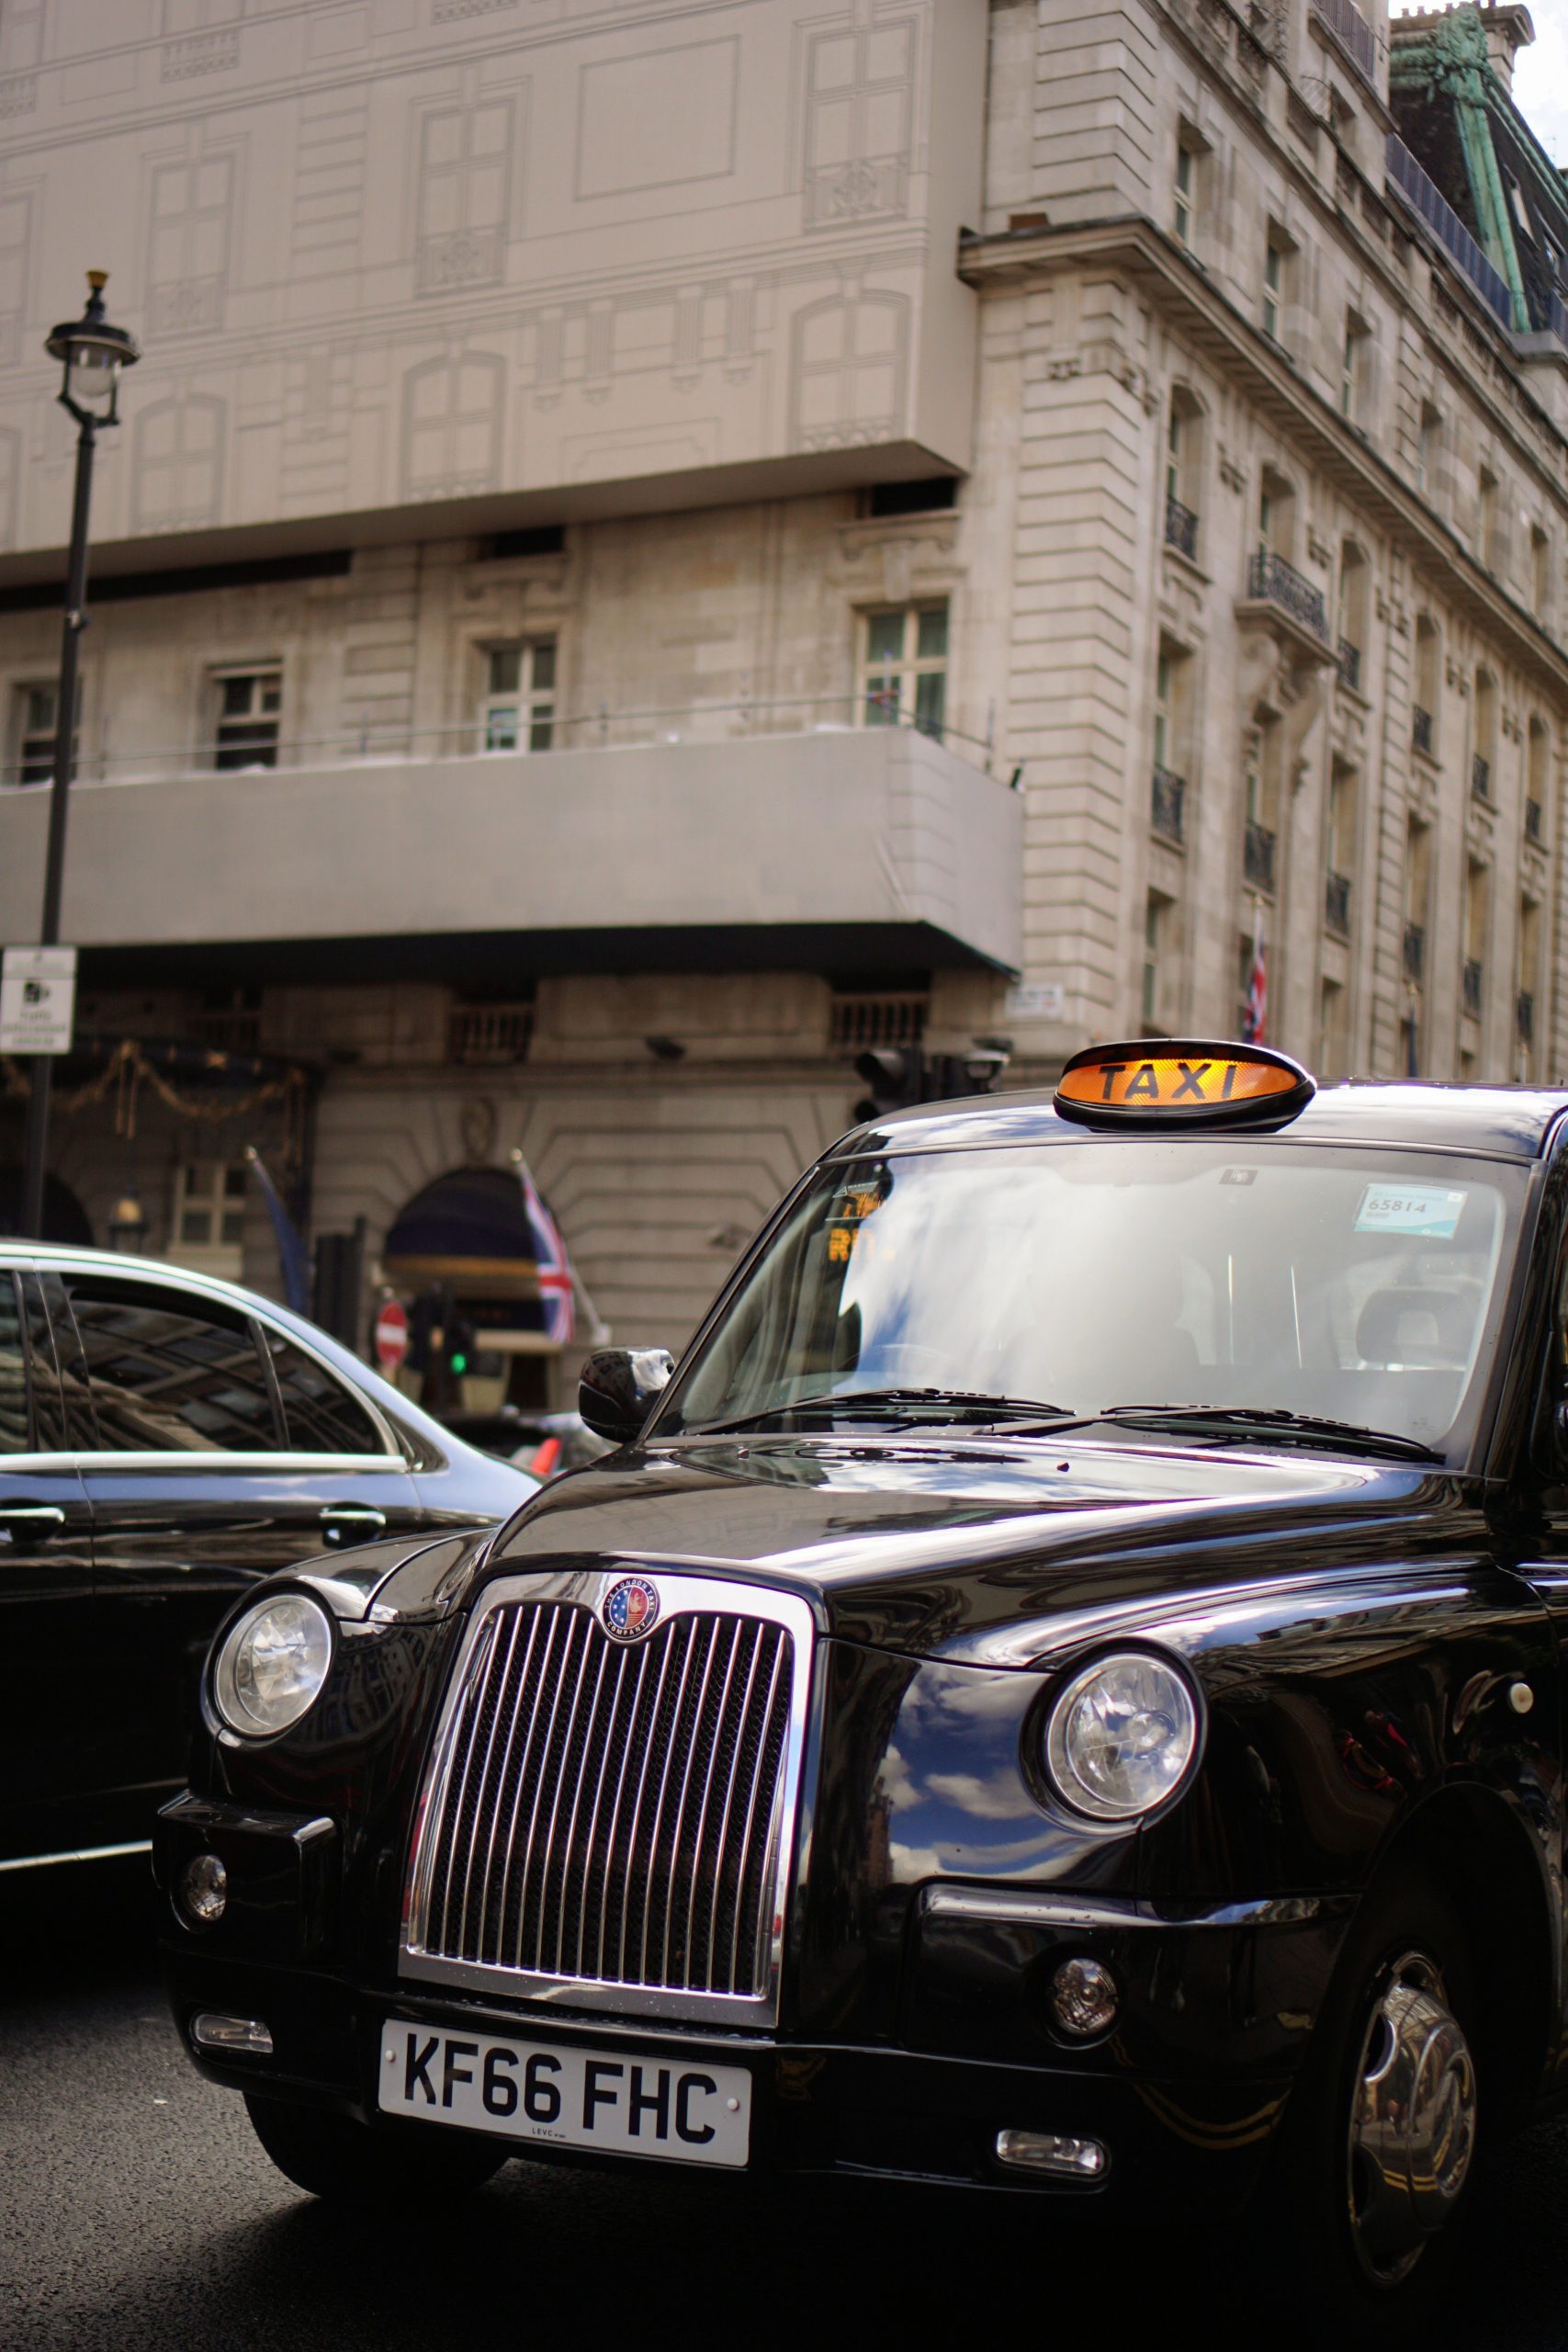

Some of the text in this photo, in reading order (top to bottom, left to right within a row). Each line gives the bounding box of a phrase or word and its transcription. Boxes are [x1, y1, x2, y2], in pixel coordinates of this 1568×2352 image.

[1099, 1062, 1236, 1100] TAXI
[1369, 1199, 1427, 1213] 65814
[604, 1579, 655, 1610] THE LONDON TAXI
[607, 1621, 647, 1635] COMPANY
[404, 2032, 717, 2144] KF66 FHC
[532, 2127, 552, 2137] LEVC
